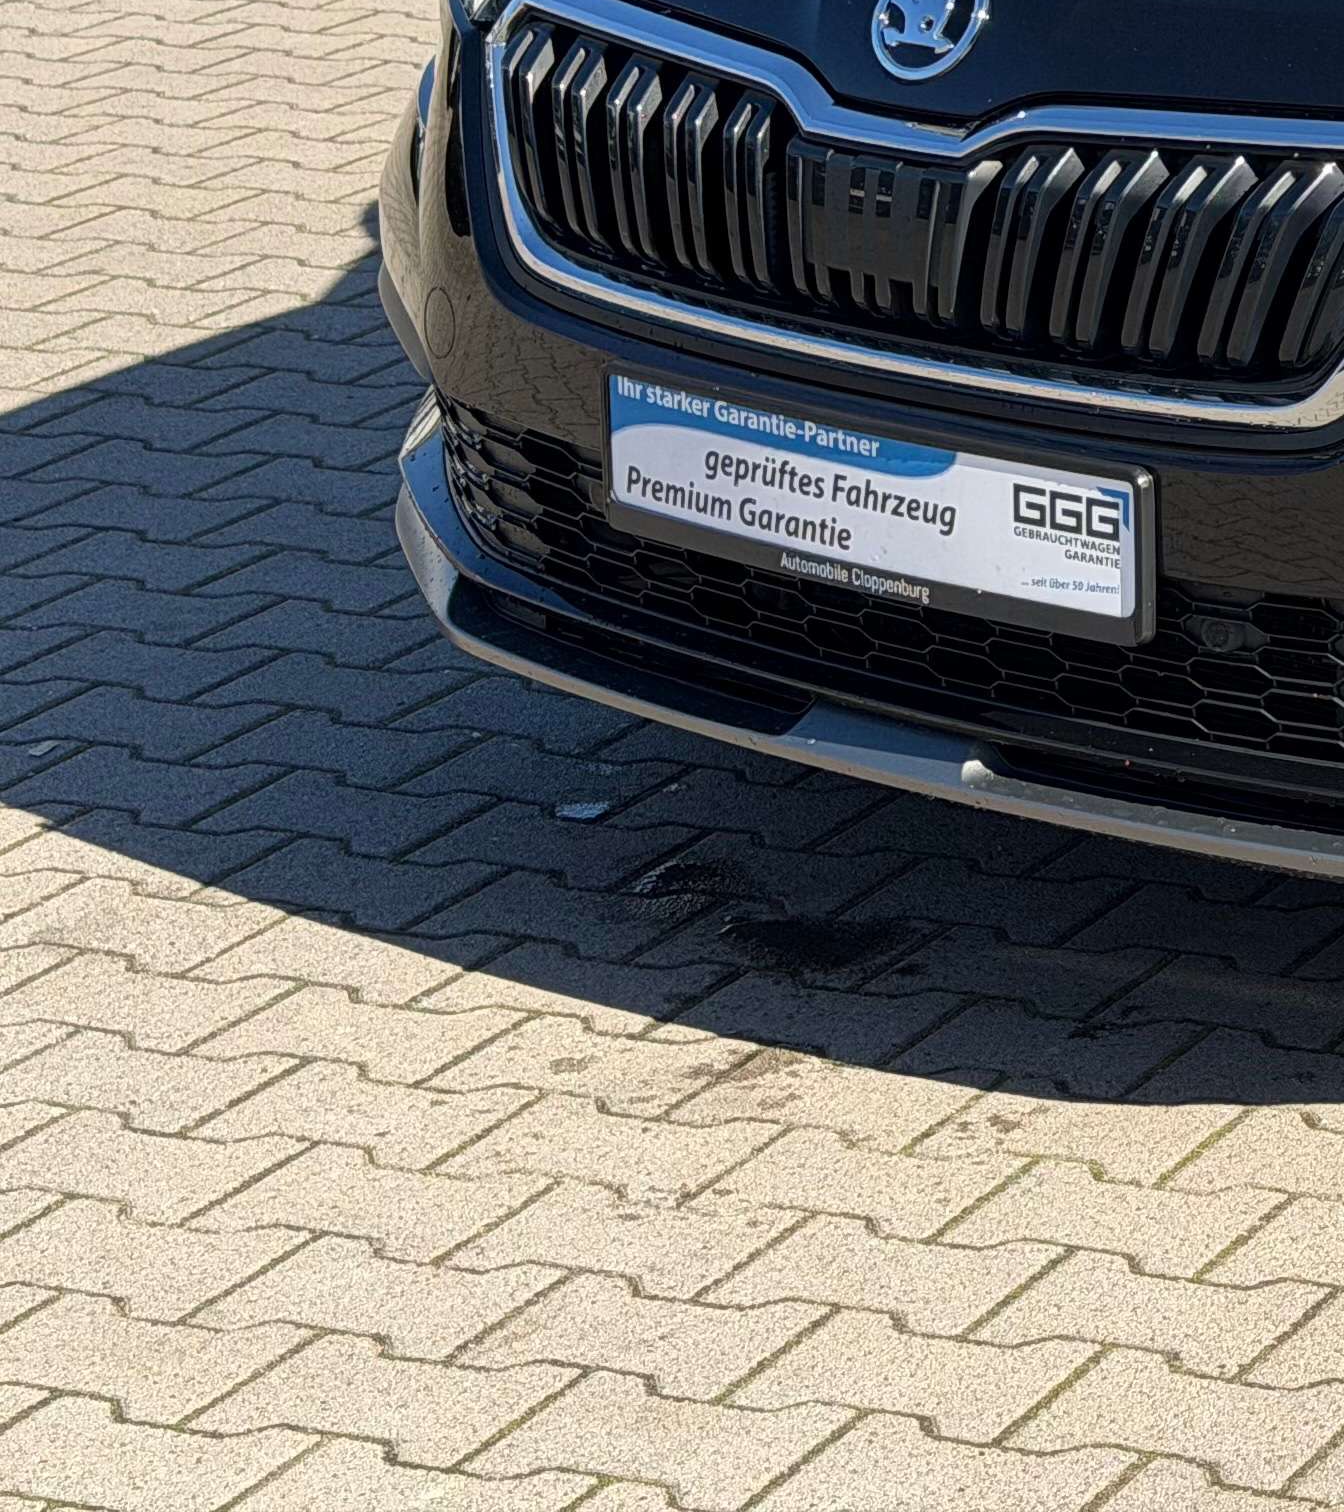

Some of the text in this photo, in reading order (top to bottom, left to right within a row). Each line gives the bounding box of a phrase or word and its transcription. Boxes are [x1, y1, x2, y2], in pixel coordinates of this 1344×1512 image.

[617, 375, 881, 458] Ihr starker Garantie-Partner
[626, 464, 853, 552] Premium Garantie
[704, 450, 958, 537] geprüftes Fahrzeug
[1012, 482, 1121, 543] GGG
[1013, 525, 1121, 557] GEBRAUCHTWAGEN
[1064, 549, 1121, 570] GARANTIE
[780, 551, 931, 605] Automobile Cloppenburg
[1031, 576, 1049, 588] seit
[1049, 576, 1070, 590] über
